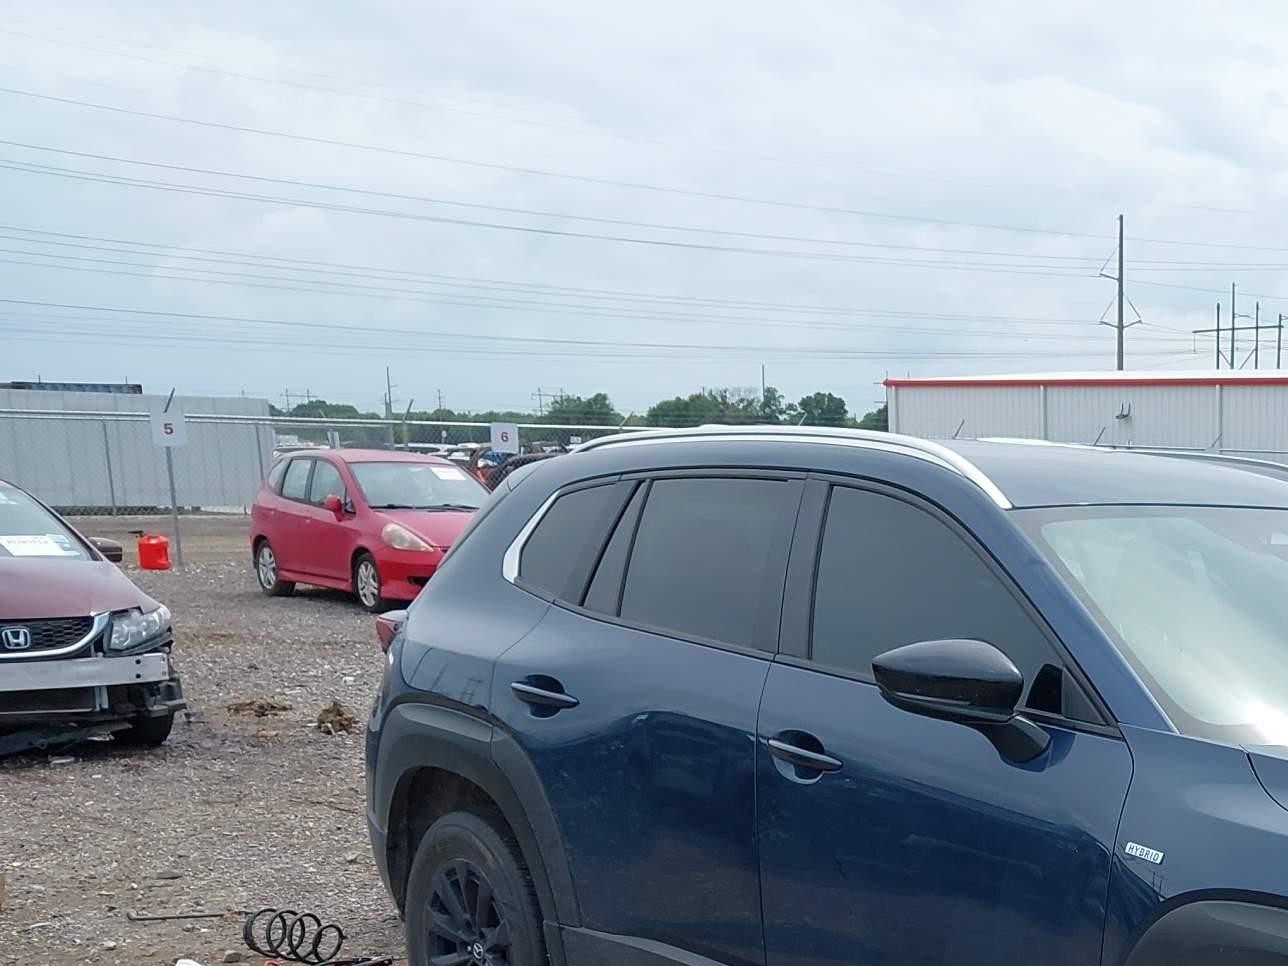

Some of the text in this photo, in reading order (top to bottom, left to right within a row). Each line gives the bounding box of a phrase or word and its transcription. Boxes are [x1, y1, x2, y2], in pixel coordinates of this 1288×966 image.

[164, 423, 174, 435] 5
[501, 432, 509, 442] 6
[1128, 844, 1160, 862] HYBRID
